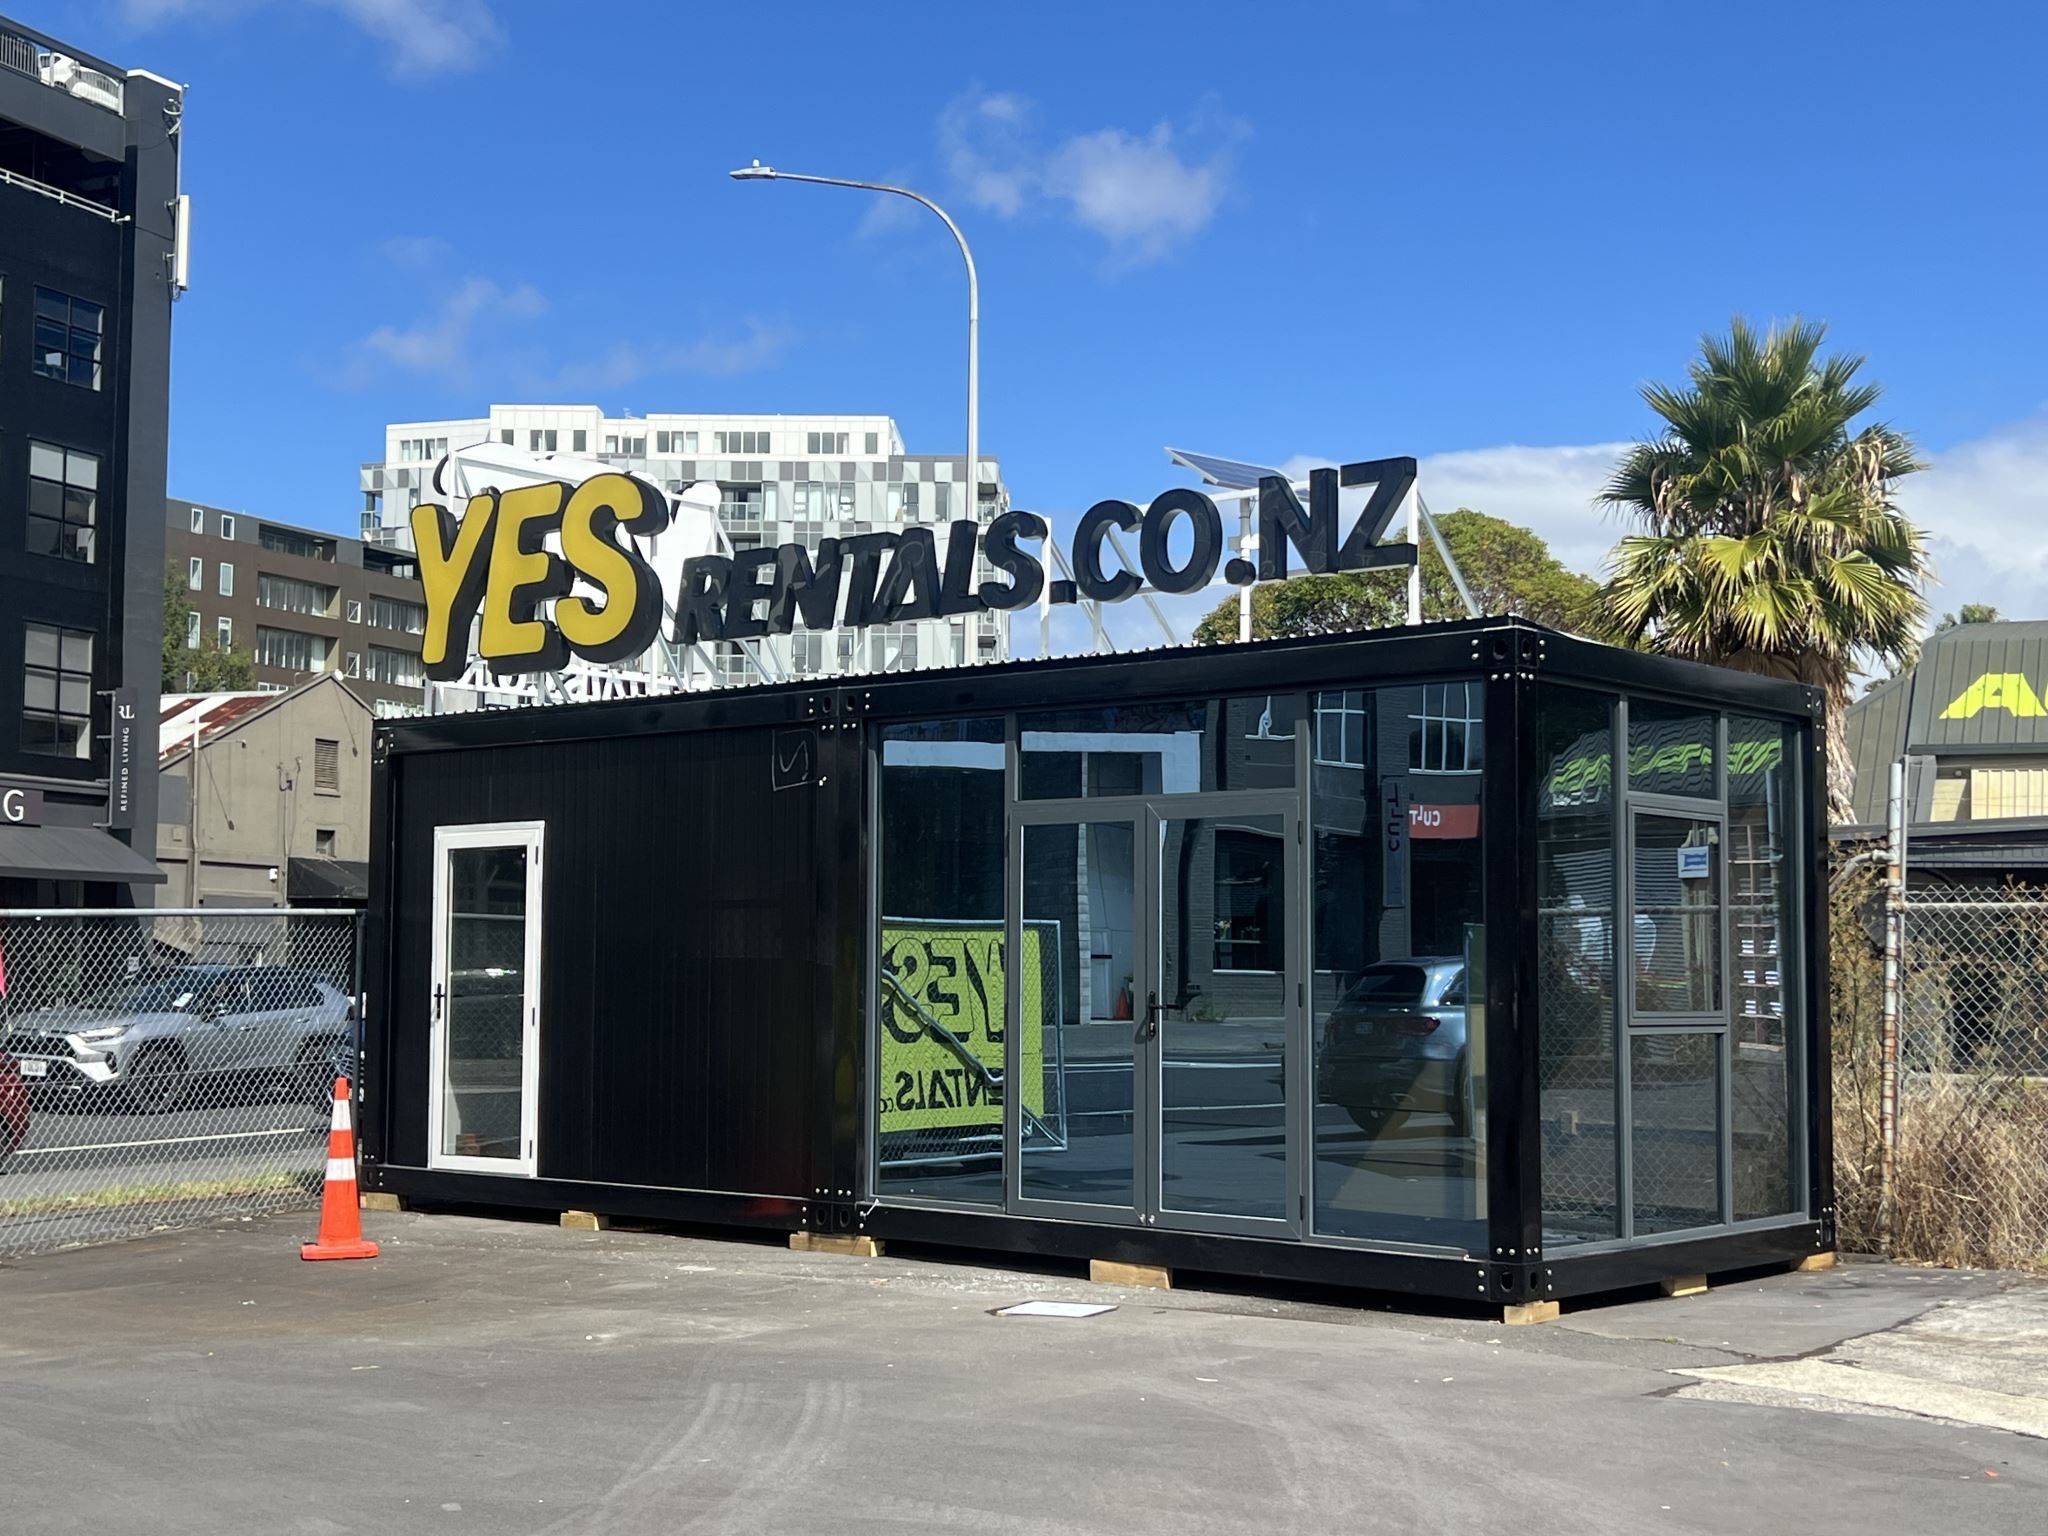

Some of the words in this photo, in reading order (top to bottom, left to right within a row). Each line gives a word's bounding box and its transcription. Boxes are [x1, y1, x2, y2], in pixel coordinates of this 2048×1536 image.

[411, 472, 669, 681] YES
[122, 726, 130, 763] LIVING
[3, 789, 24, 822] G
[120, 767, 129, 811] REFINED
